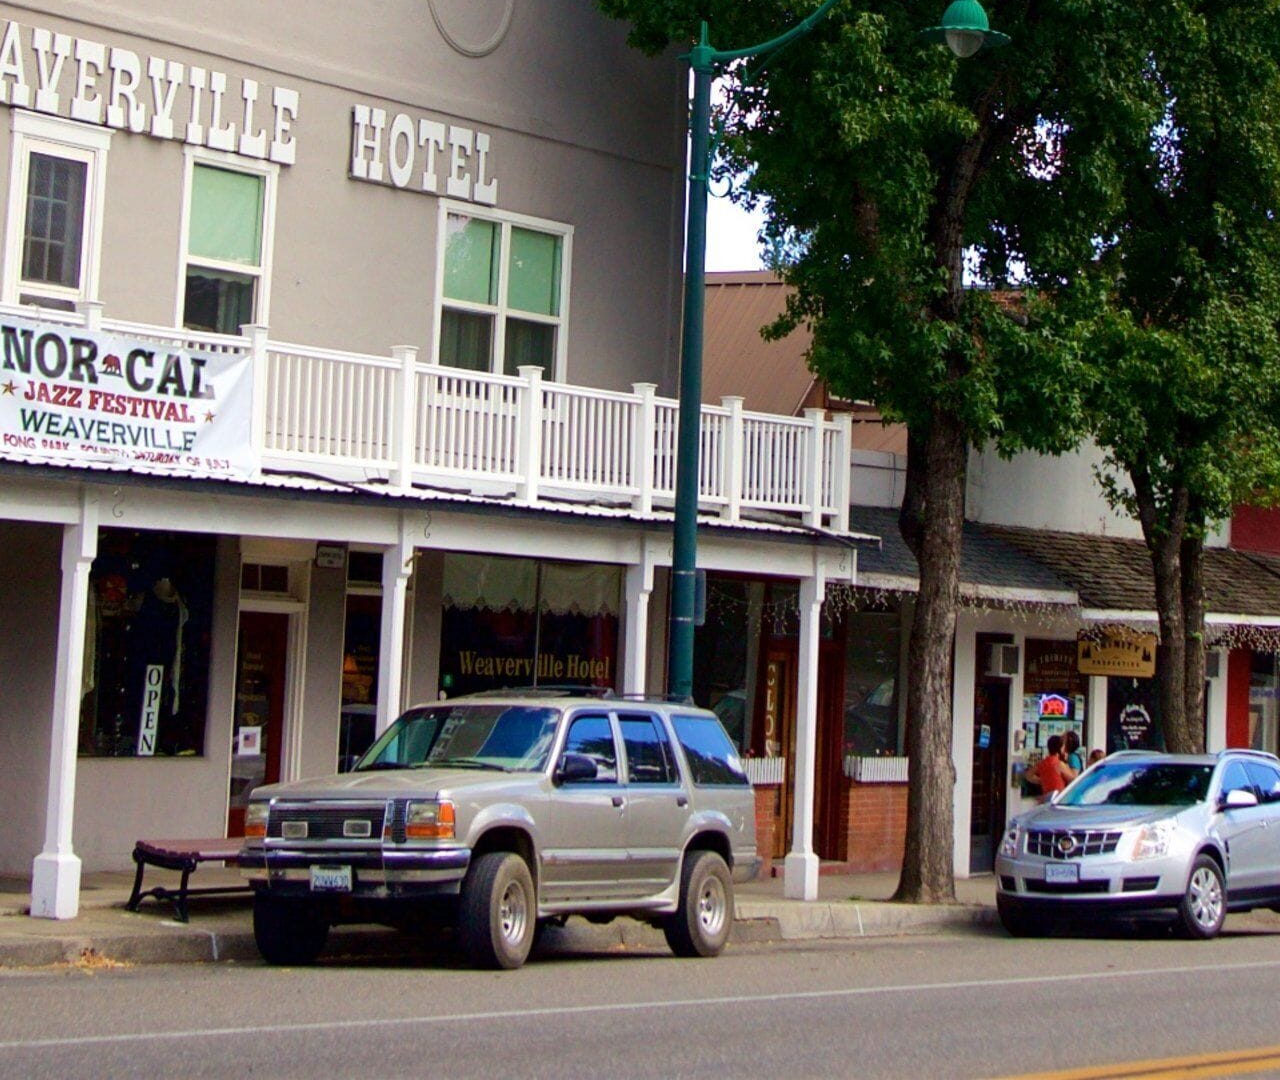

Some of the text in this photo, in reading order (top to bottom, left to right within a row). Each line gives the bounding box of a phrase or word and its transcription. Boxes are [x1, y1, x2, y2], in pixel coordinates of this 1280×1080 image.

[352, 103, 498, 206] HOTEL
[0, 325, 215, 400] NOR CAL
[24, 380, 195, 423] JAZZ FESTIVAL
[4, 433, 36, 449] FONG
[20, 408, 197, 452] WEAVERVILLE
[459, 650, 610, 680] Weaverville Hotel
[140, 667, 161, 754] OPEN
